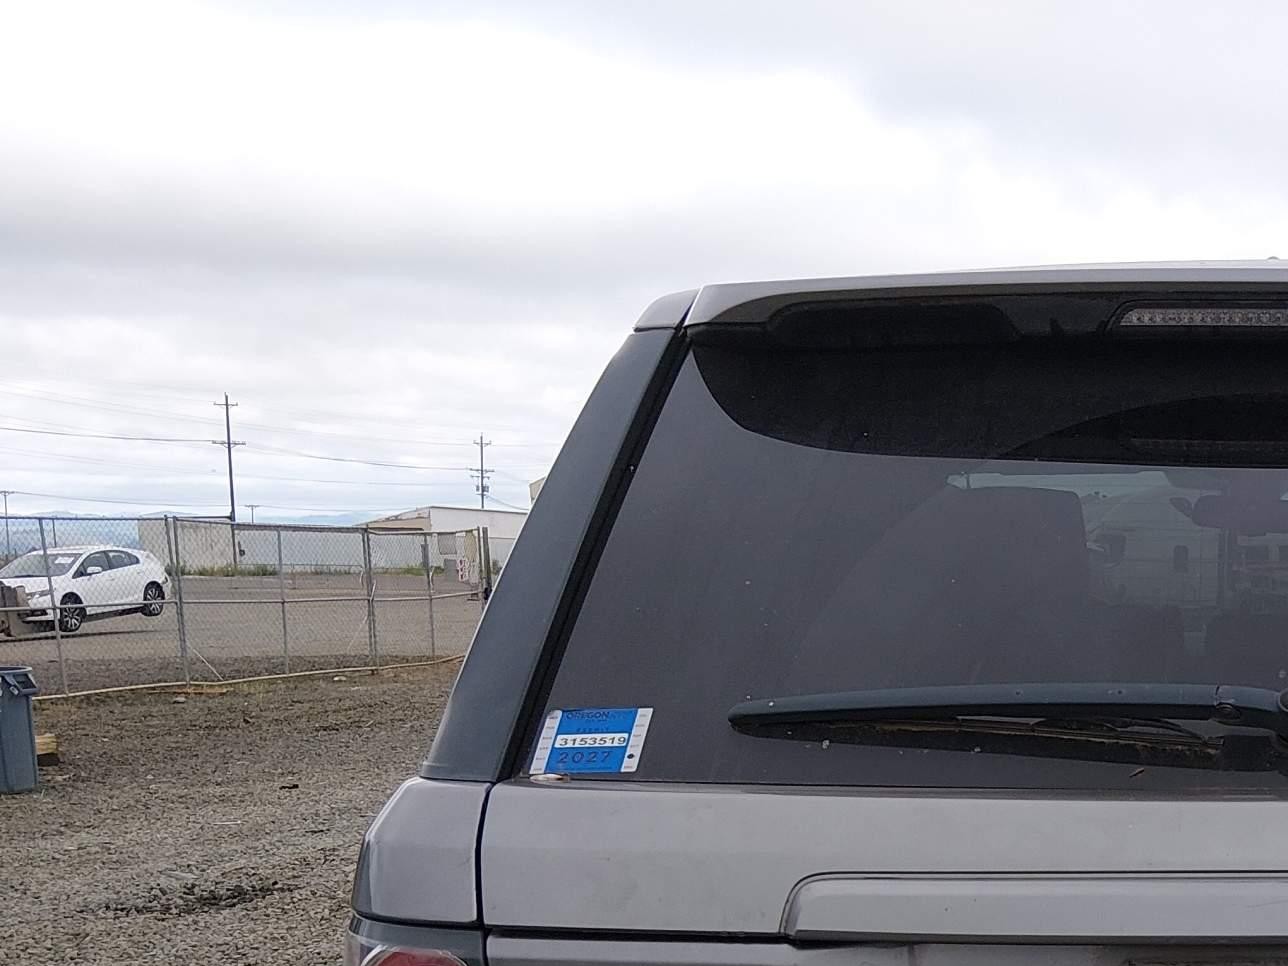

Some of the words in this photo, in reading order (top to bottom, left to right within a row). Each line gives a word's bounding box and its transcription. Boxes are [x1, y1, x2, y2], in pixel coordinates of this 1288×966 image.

[565, 711, 610, 720] OREGON
[559, 736, 627, 747] 3153519
[556, 750, 613, 764] 2027
